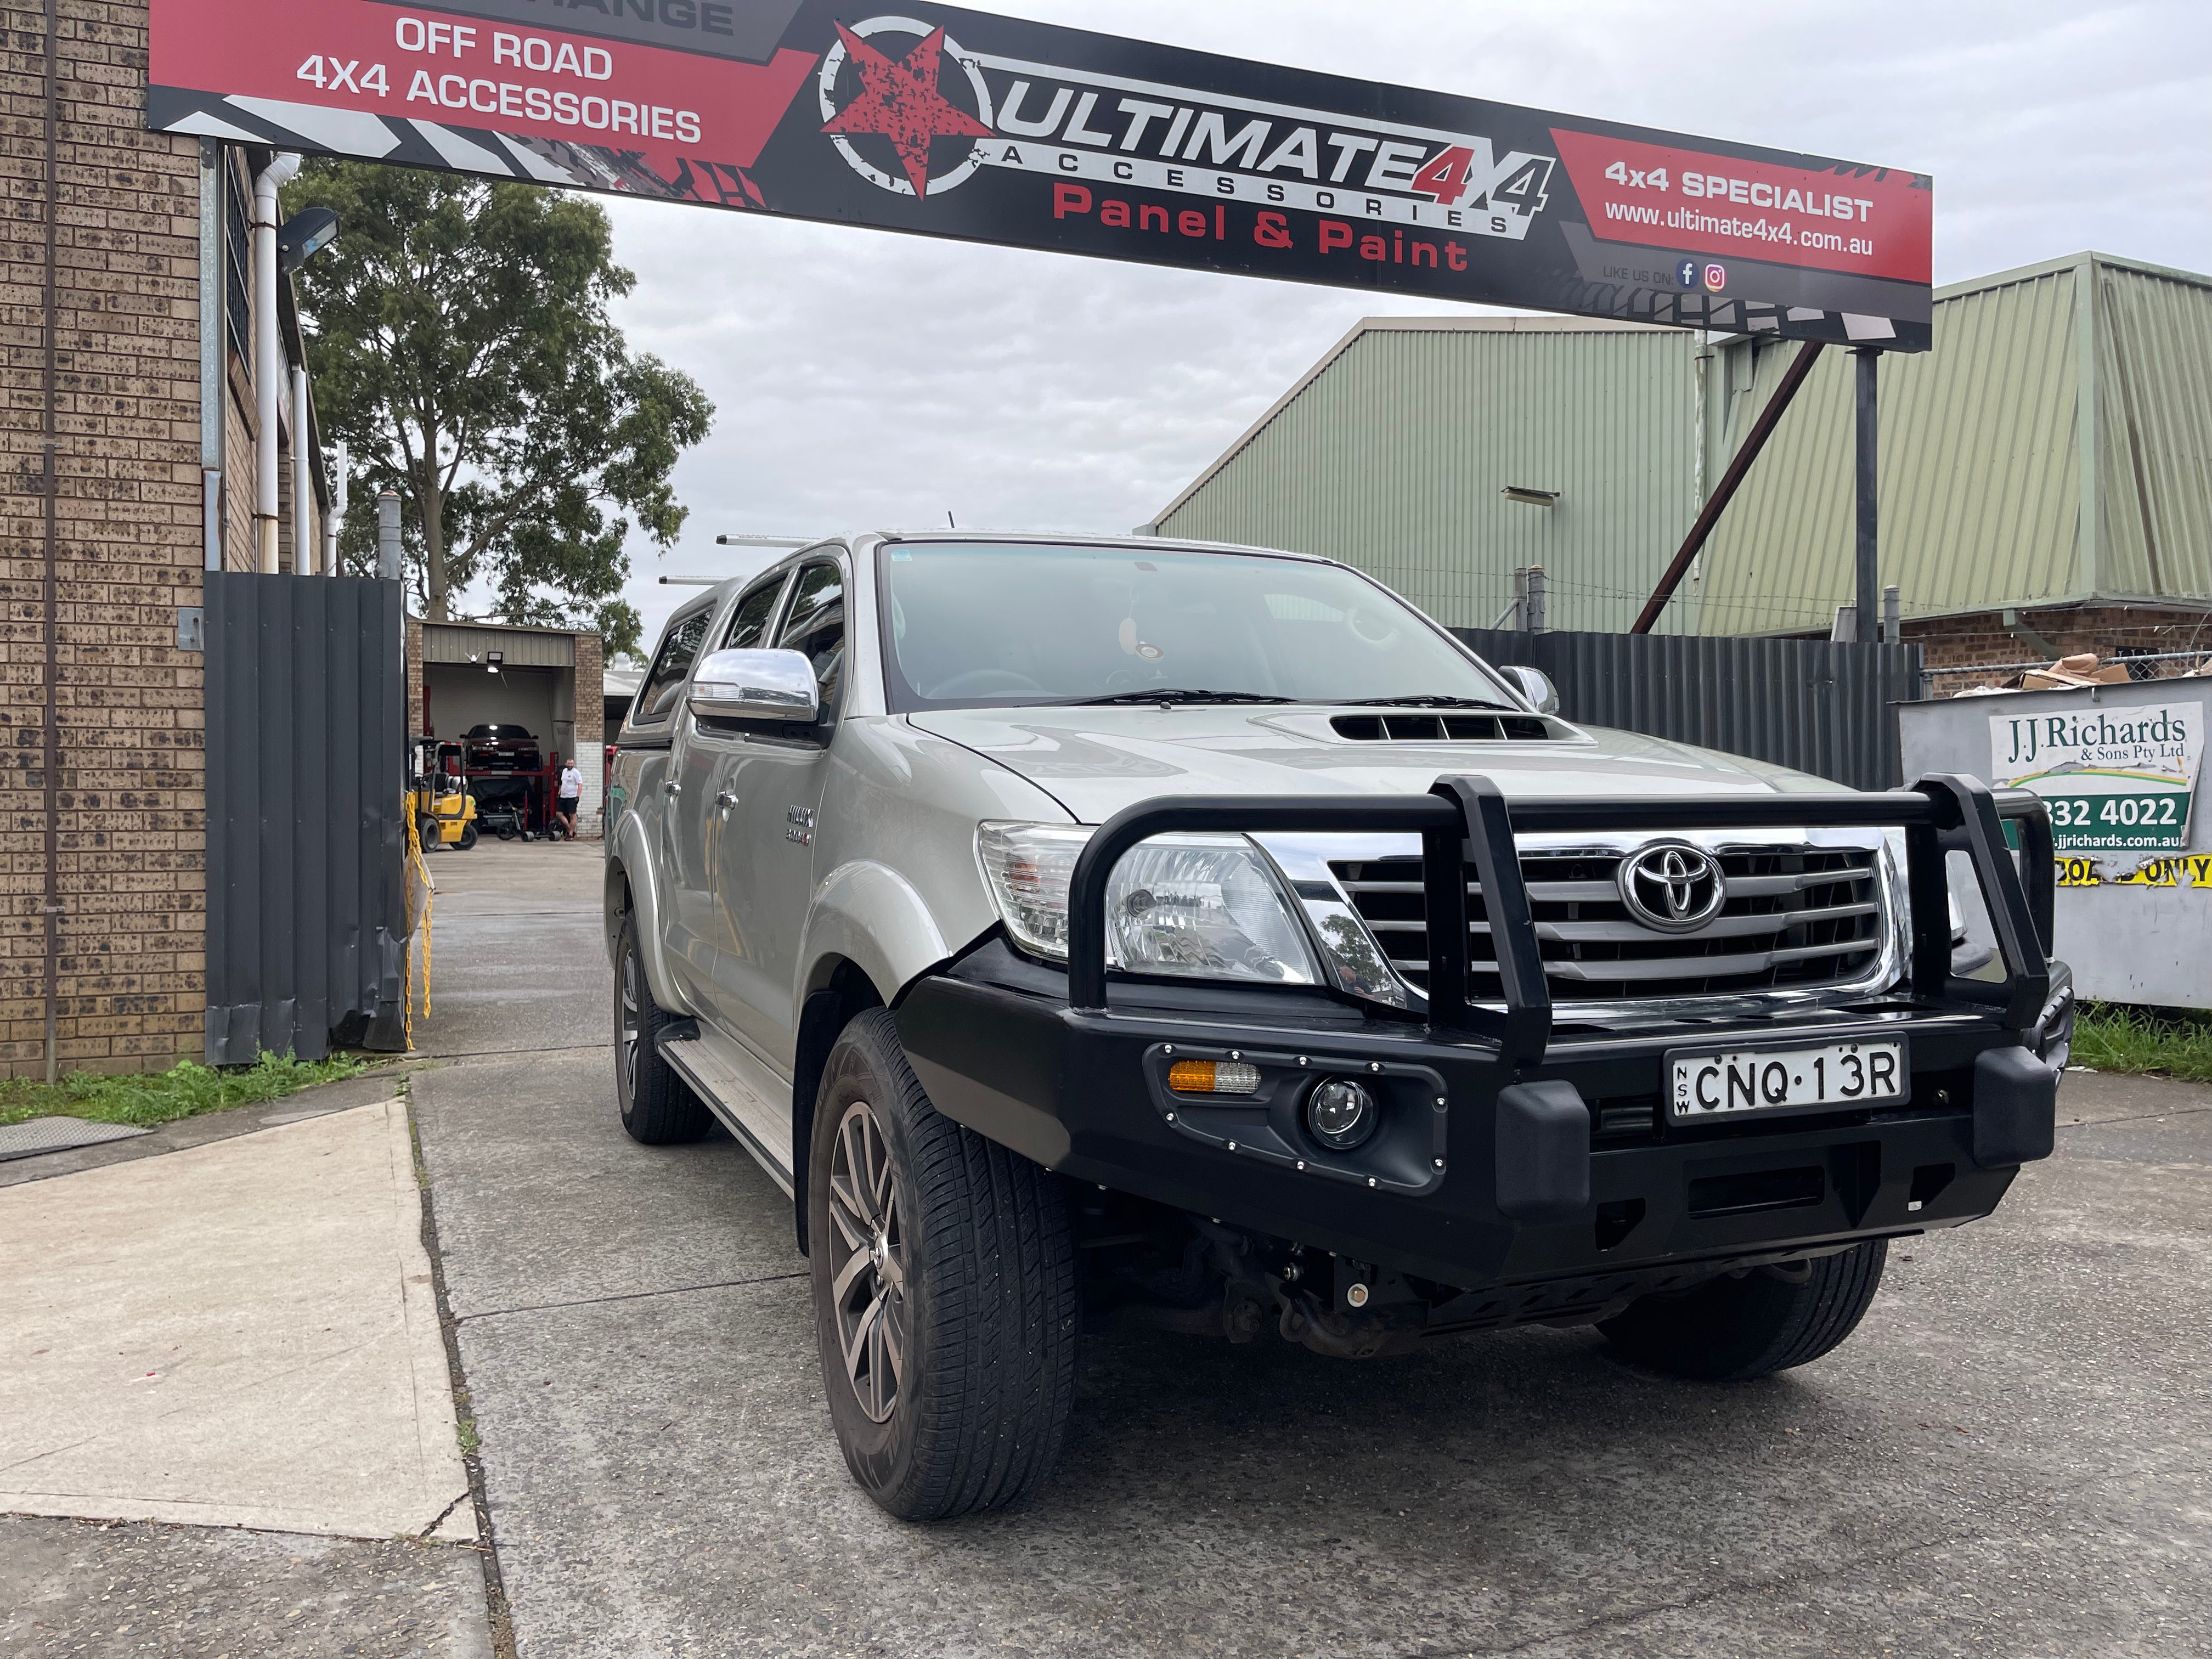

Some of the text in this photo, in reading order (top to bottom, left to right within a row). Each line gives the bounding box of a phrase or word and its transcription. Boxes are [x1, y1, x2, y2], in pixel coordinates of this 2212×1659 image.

[396, 16, 612, 81] OFF ROAD
[296, 54, 702, 144] 4X4 ACCESSORIES
[1001, 145, 1506, 233] ACCESSORIES
[1605, 161, 1874, 223] 4x4 SPECIALIST
[1053, 182, 1468, 272] Panel & Paint
[1605, 201, 1873, 256] www.ultimate4x4.com.au
[1603, 265, 1629, 280] LIKE
[1633, 269, 1649, 282] US
[2081, 742, 2185, 763] & Sons Pty Ltd
[2100, 798, 2177, 826] 4022
[2053, 833, 2179, 849] .jjrichards.com.au
[1676, 1066, 1690, 1114] NSW
